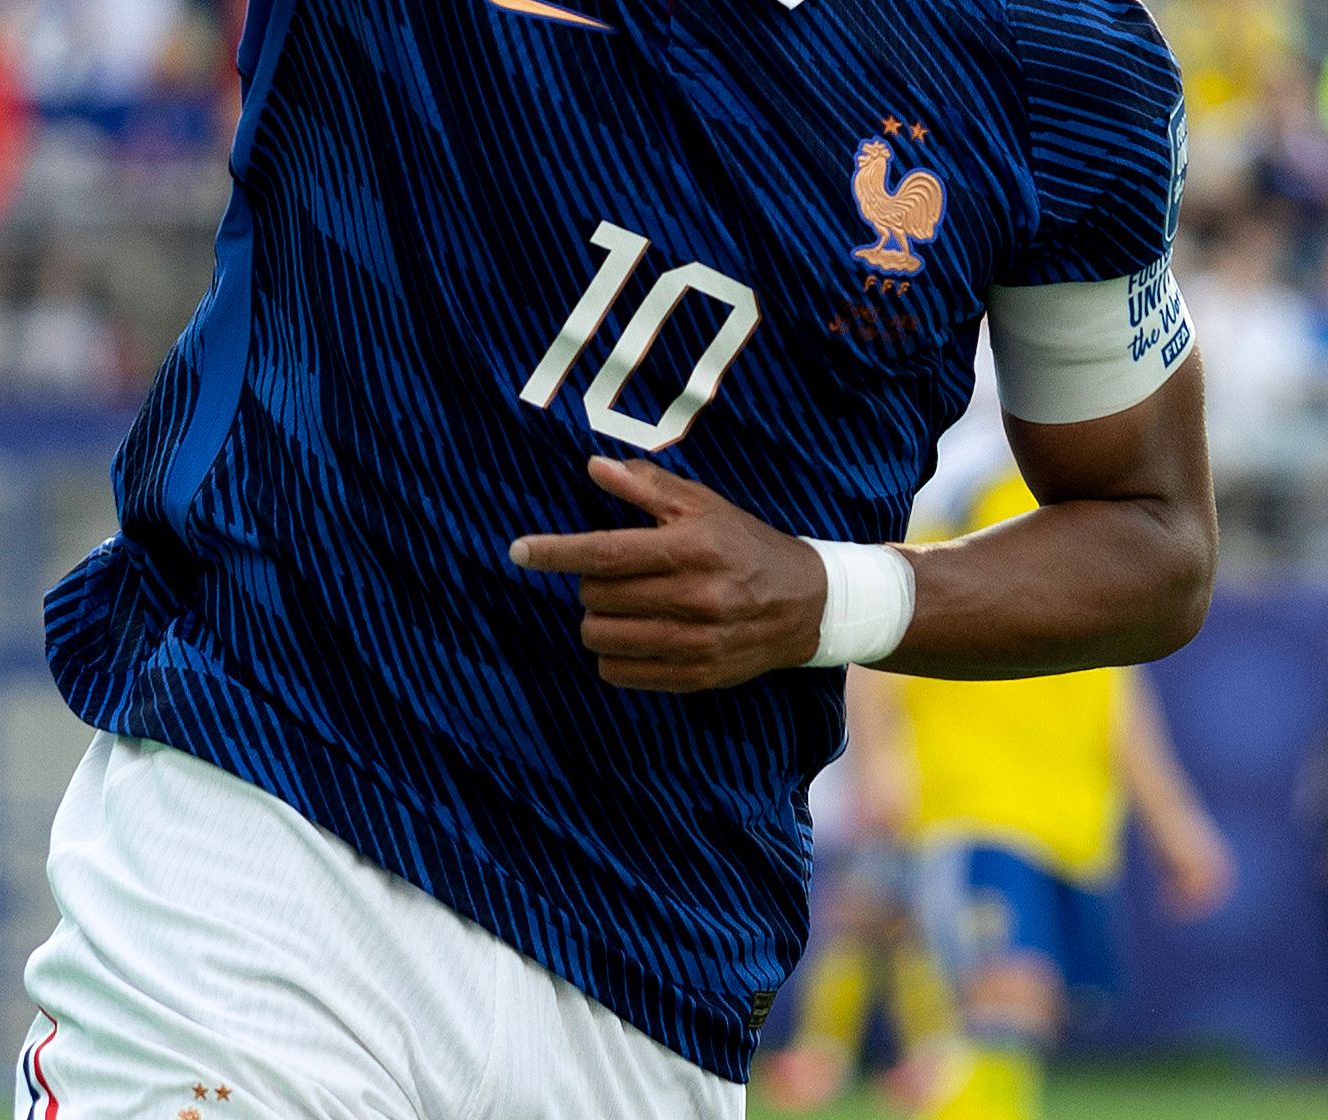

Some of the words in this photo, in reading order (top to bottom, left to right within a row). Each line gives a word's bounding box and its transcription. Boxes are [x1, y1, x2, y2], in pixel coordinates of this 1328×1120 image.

[519, 219, 762, 452] 10
[1127, 327, 1160, 361] the
[1163, 323, 1190, 364] FIFA
